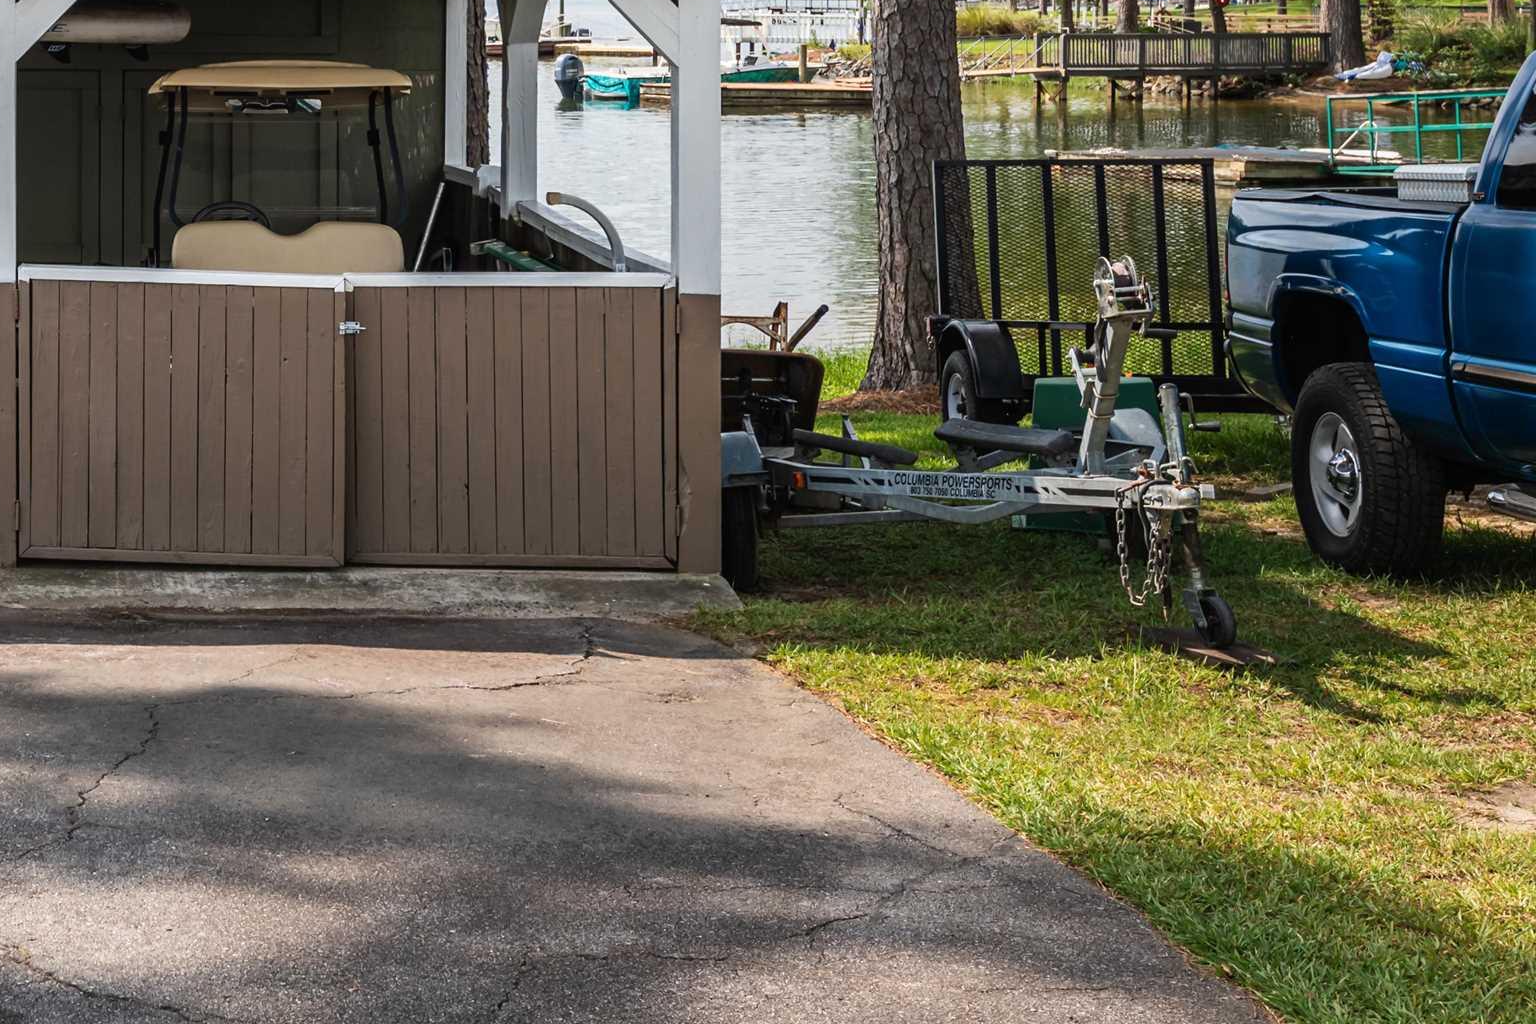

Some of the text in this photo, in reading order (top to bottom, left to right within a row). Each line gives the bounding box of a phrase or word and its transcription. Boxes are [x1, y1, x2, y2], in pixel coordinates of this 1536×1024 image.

[894, 473, 1013, 491] COLUMBIA POWERSPORTS
[950, 487, 984, 498] COLUMBIA
[986, 489, 996, 499] SC
